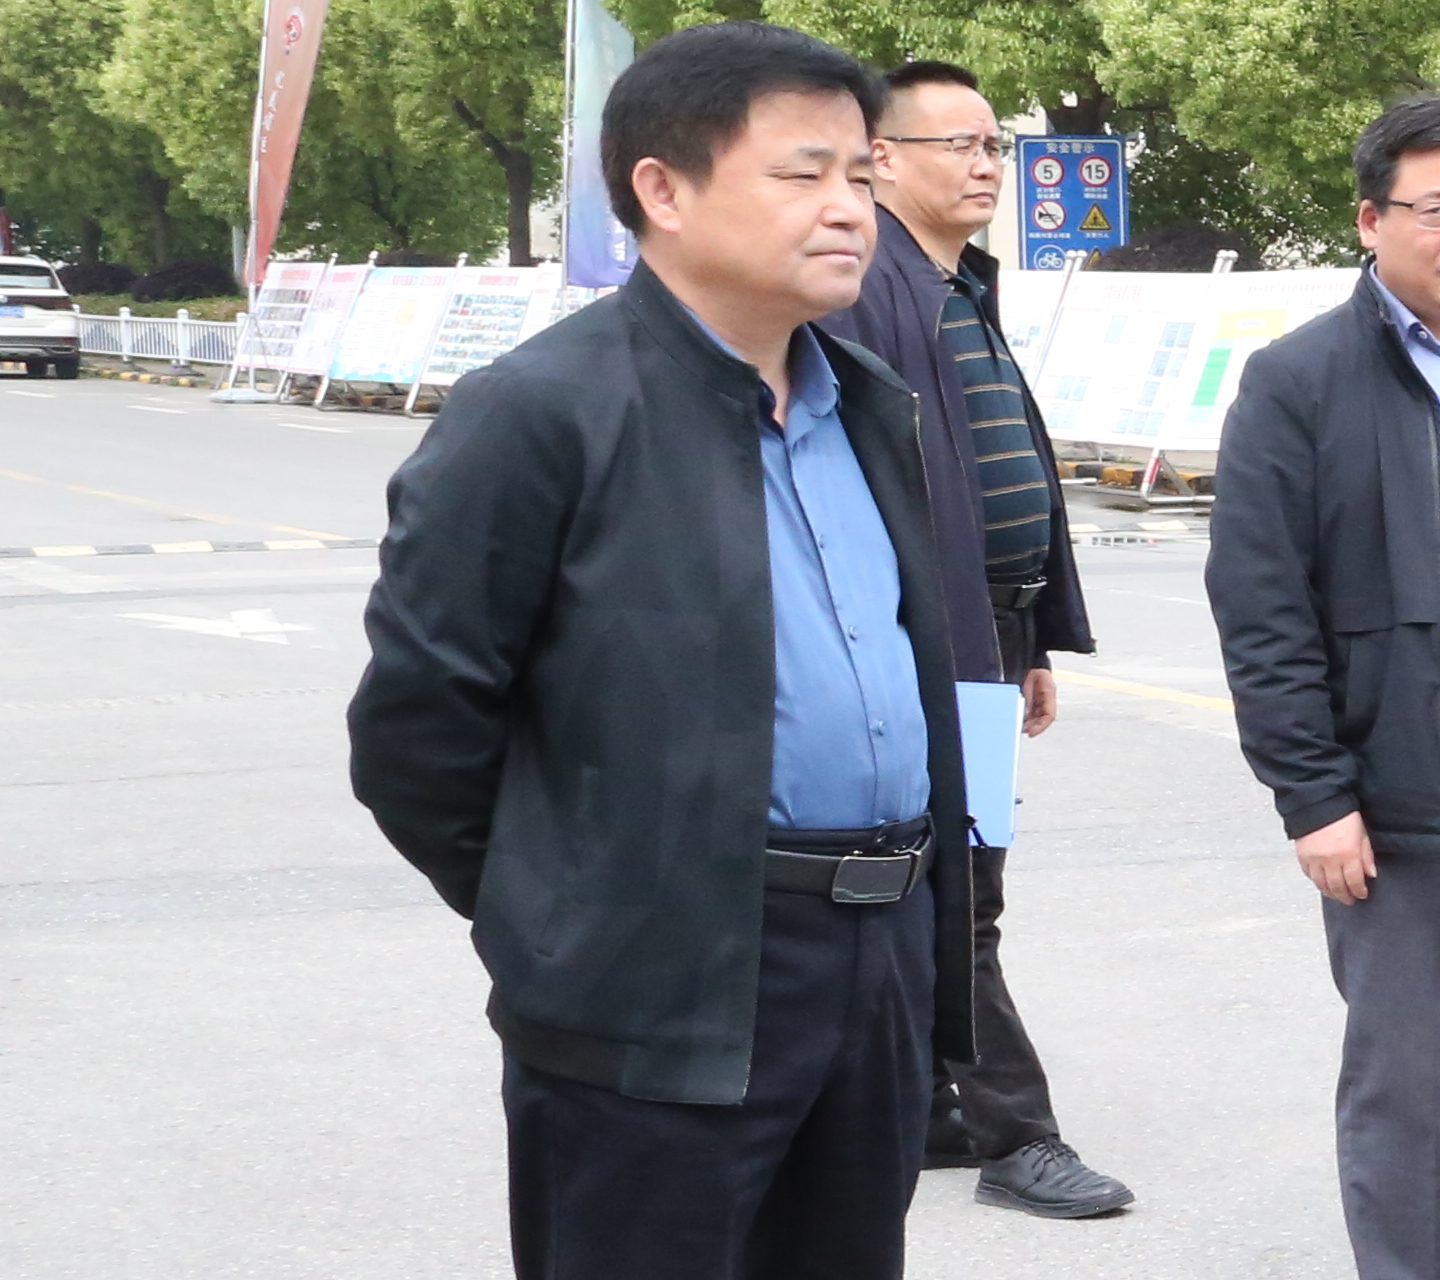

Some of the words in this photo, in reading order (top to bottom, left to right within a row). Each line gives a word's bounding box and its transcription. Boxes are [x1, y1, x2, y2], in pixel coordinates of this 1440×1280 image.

[1046, 142, 1095, 154] 安全警示
[1043, 164, 1054, 180] 5
[1085, 164, 1106, 180] 15
